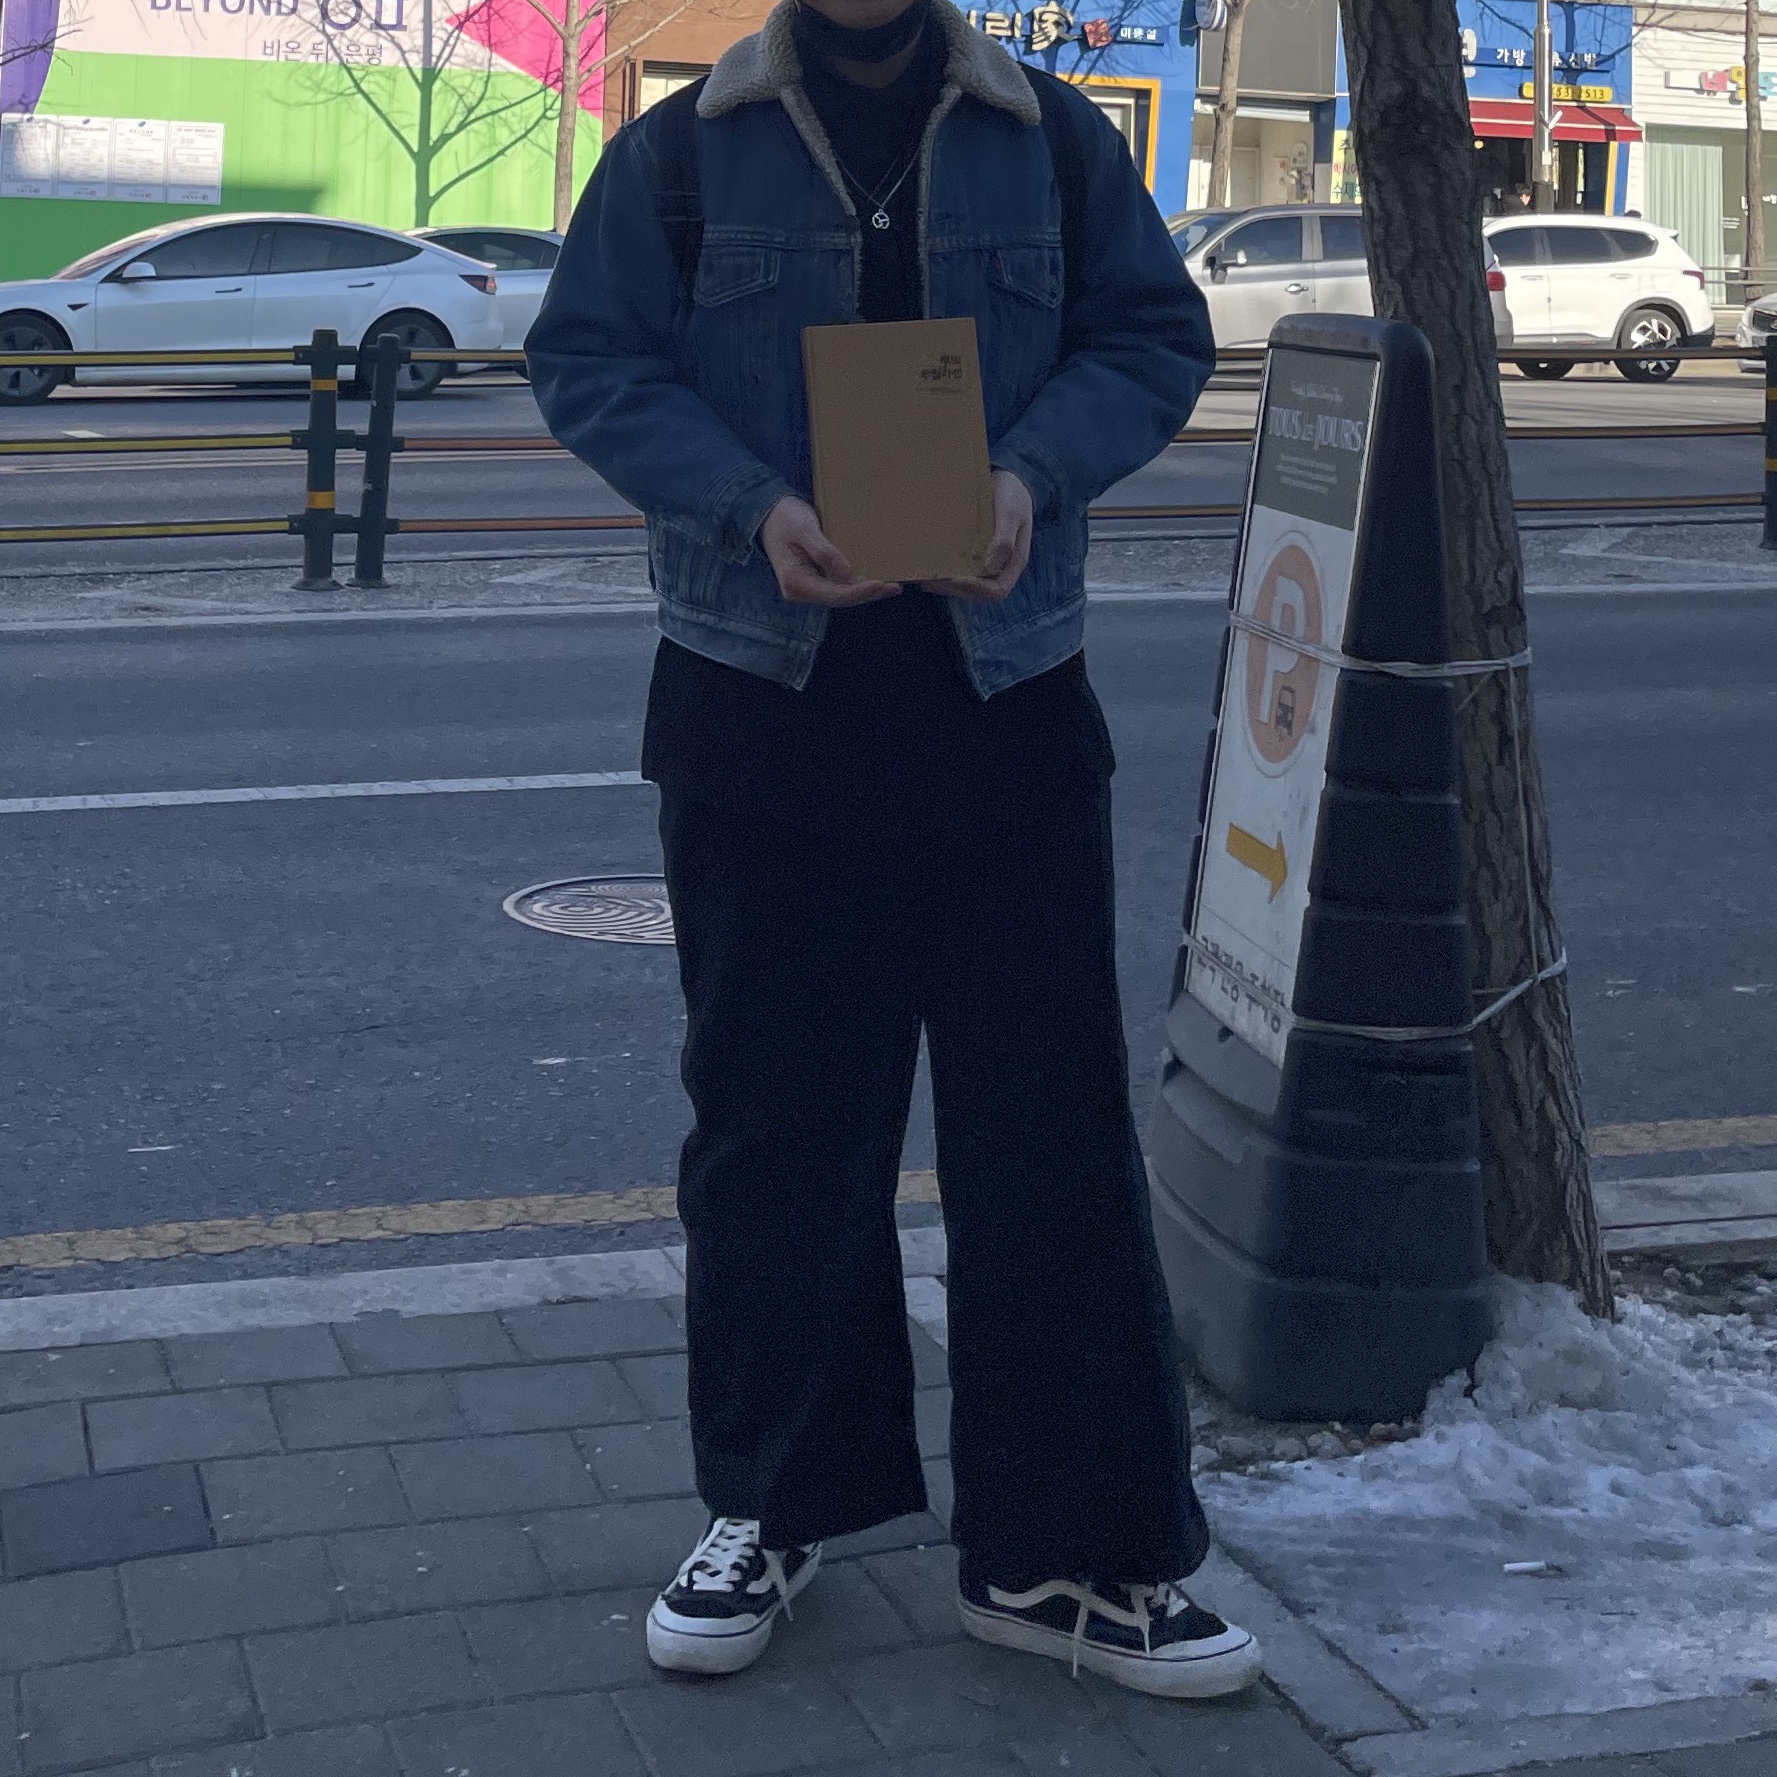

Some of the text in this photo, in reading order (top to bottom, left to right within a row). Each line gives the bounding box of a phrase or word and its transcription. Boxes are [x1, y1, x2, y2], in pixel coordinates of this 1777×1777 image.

[1120, 27, 1158, 43] 미용실
[262, 40, 383, 66] 비온 뒤 은평
[1497, 48, 1527, 67] 가방
